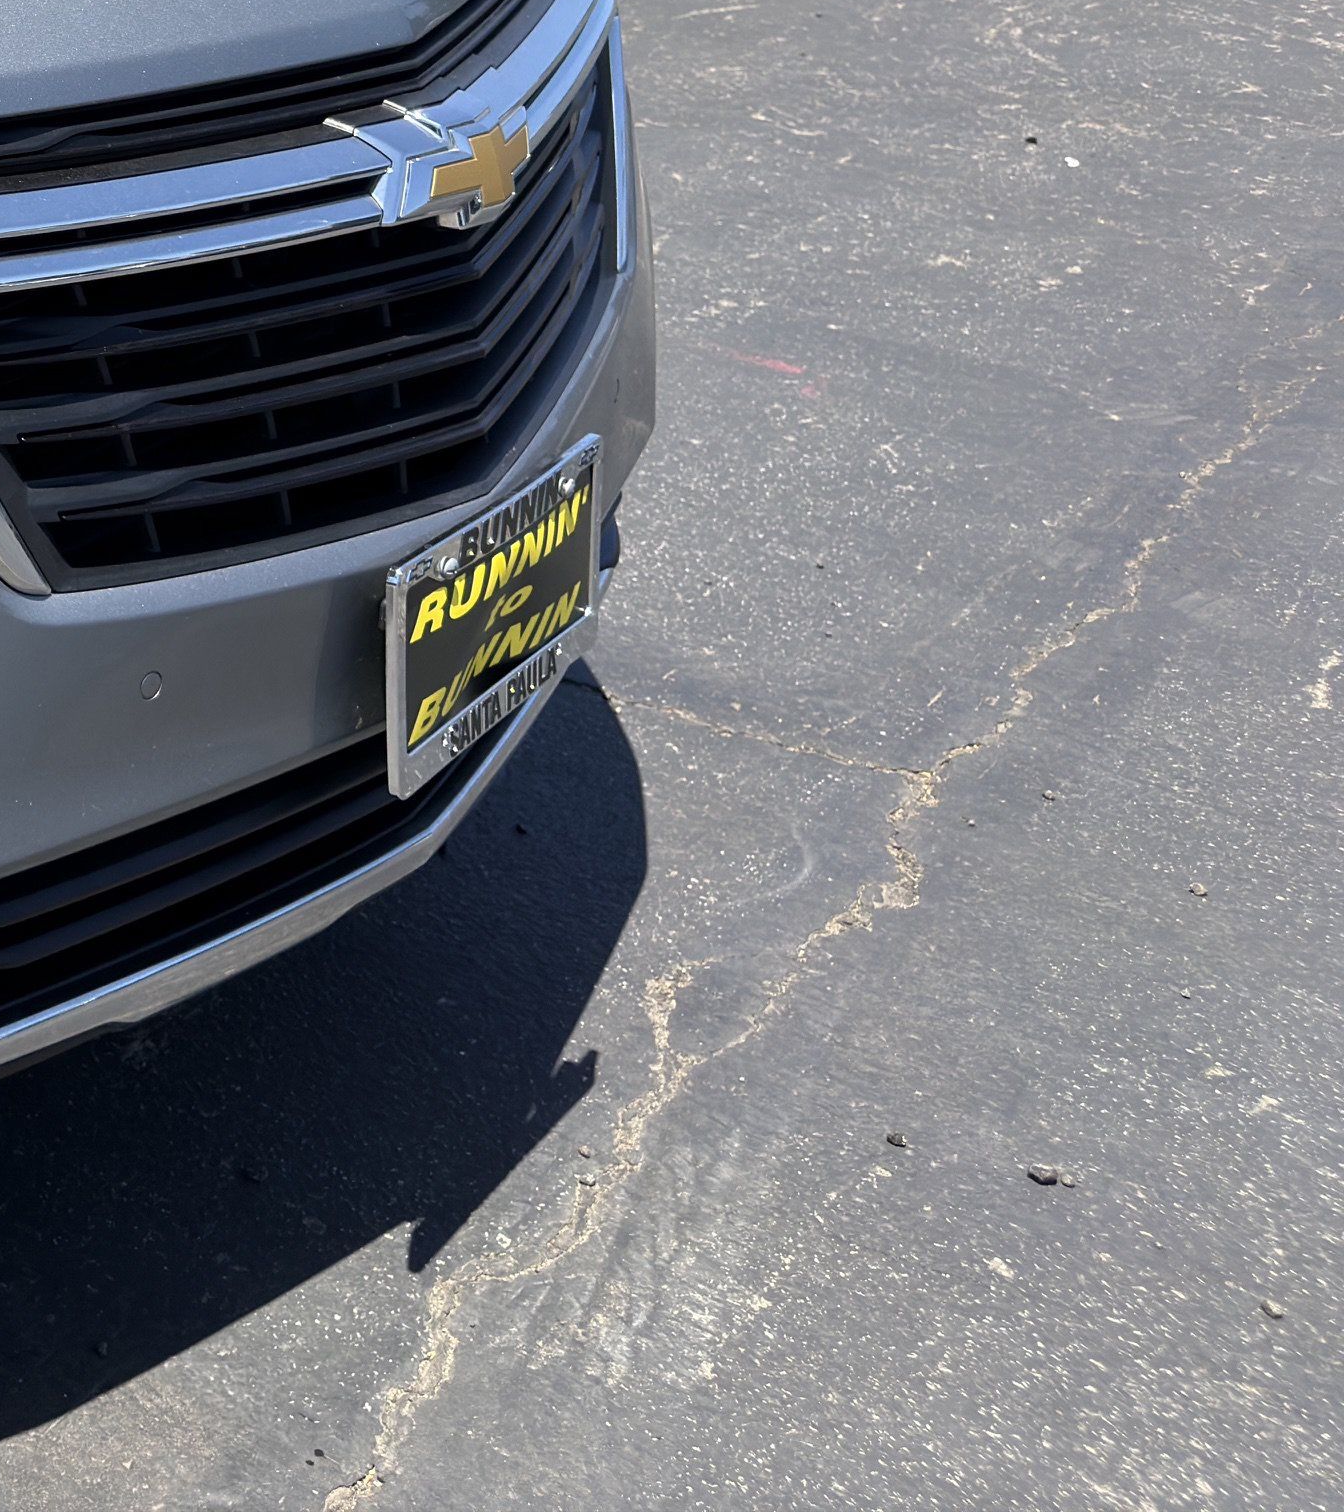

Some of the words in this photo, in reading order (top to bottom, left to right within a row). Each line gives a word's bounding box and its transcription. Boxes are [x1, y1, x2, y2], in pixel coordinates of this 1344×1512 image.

[410, 484, 590, 644] RUNNIN'
[460, 468, 562, 566] BUNNIN
[407, 580, 581, 747] BUNNIN
[484, 584, 534, 632] to
[449, 691, 502, 758] SANTA
[506, 646, 557, 712] PAULA
